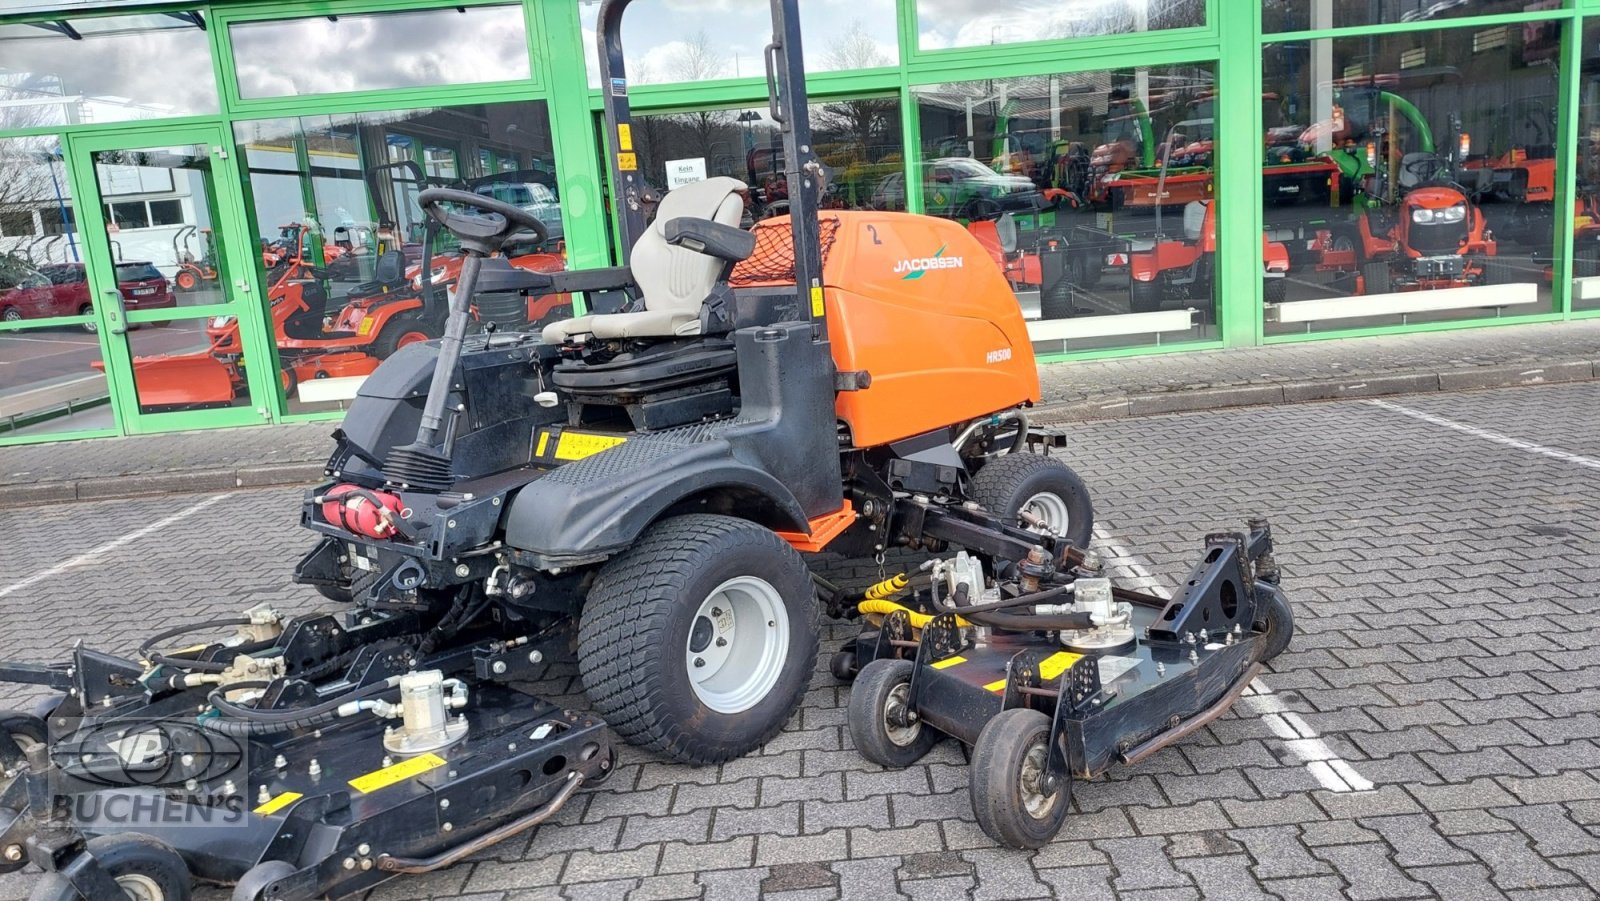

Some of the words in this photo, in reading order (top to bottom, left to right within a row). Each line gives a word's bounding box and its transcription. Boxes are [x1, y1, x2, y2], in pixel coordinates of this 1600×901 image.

[866, 224, 882, 245] 2
[893, 257, 963, 272] JACOBSEN
[986, 347, 1012, 364] HR500
